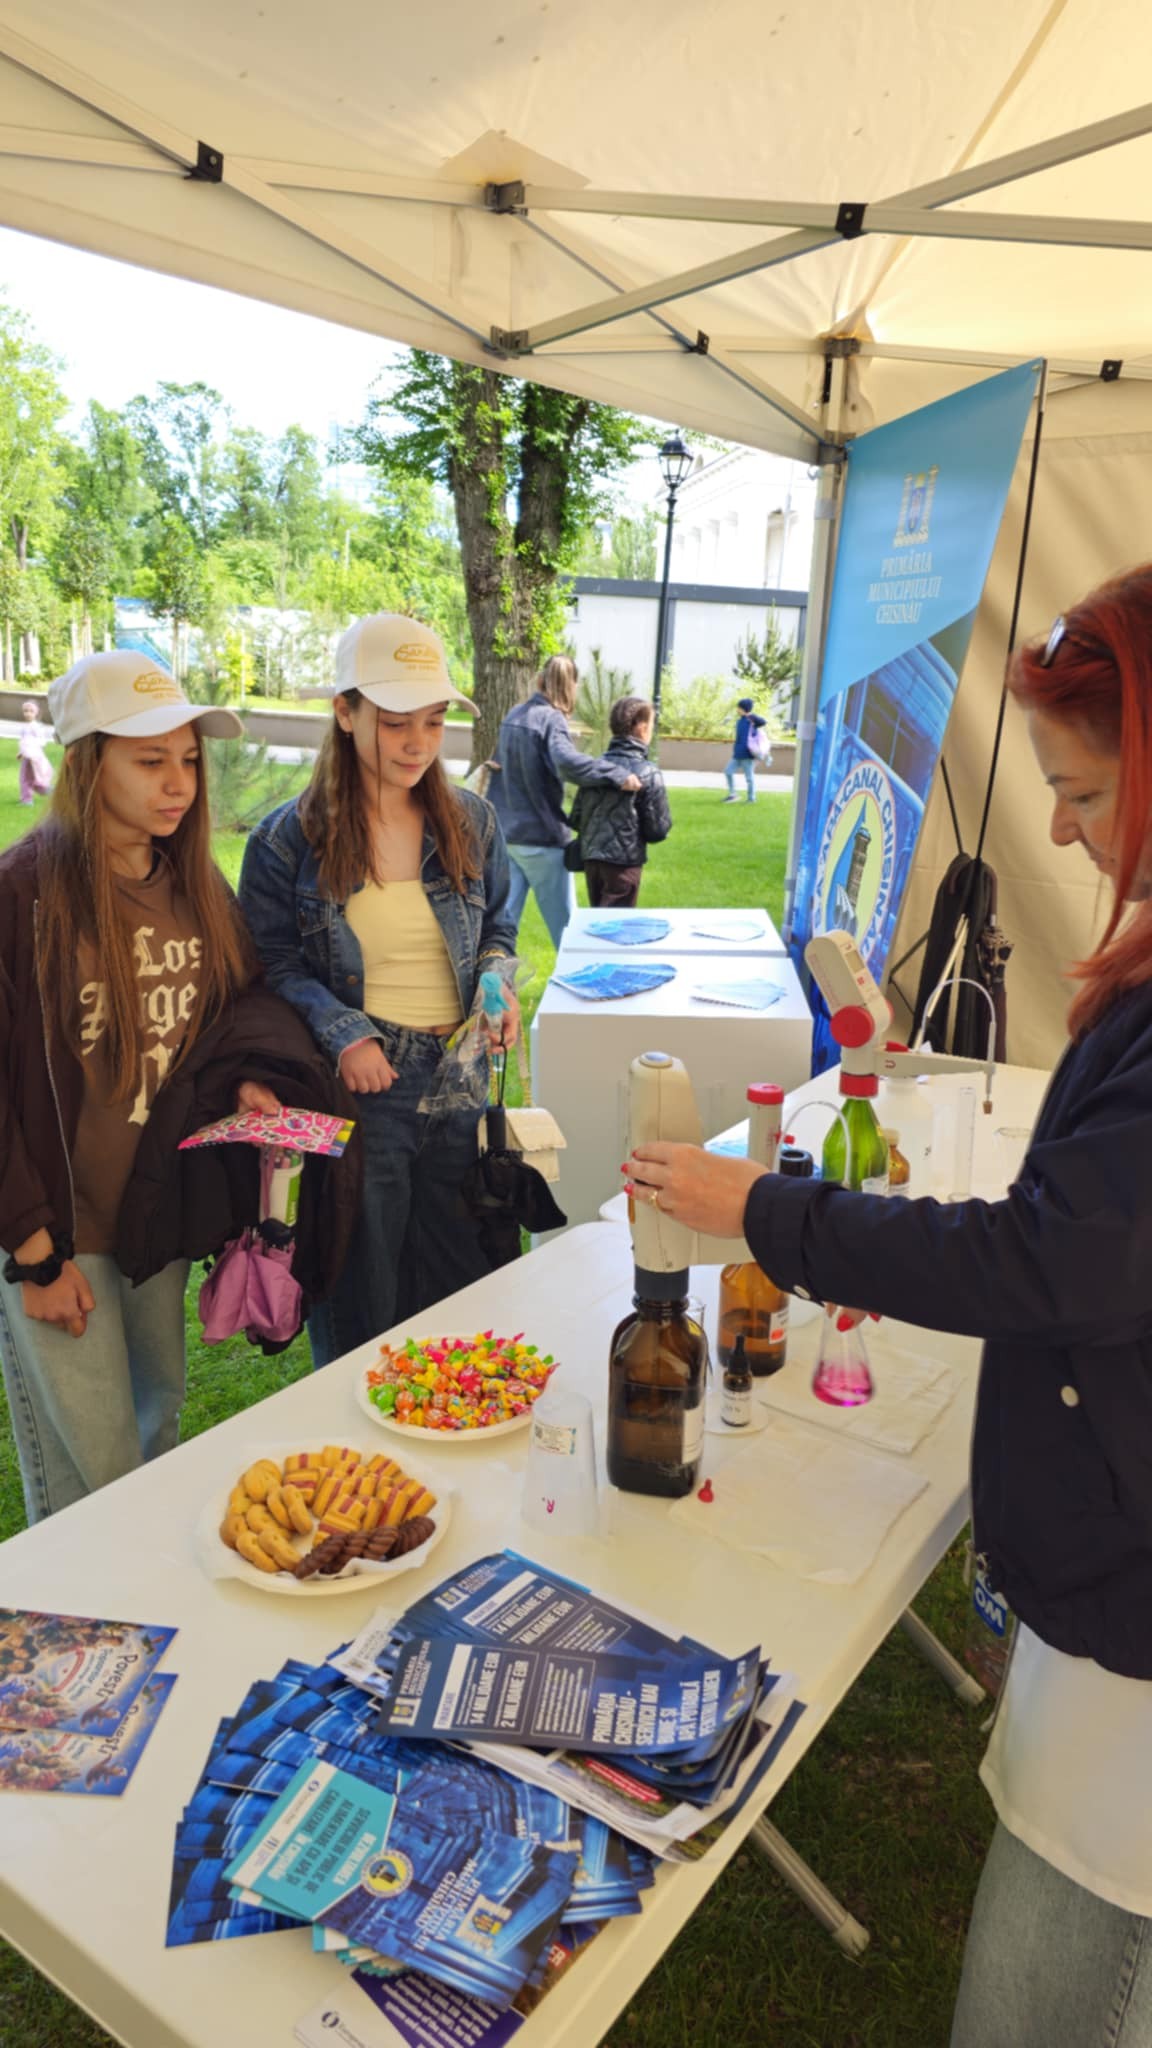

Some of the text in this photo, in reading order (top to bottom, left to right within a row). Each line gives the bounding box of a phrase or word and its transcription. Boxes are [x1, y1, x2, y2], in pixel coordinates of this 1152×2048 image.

[134, 926, 202, 977] Los
[96, 1653, 138, 1697] Povesti
[469, 1651, 501, 1725] 14 MILIOANE EUR
[512, 1660, 529, 1678] EUR
[502, 1676, 526, 1720] MILIOANE
